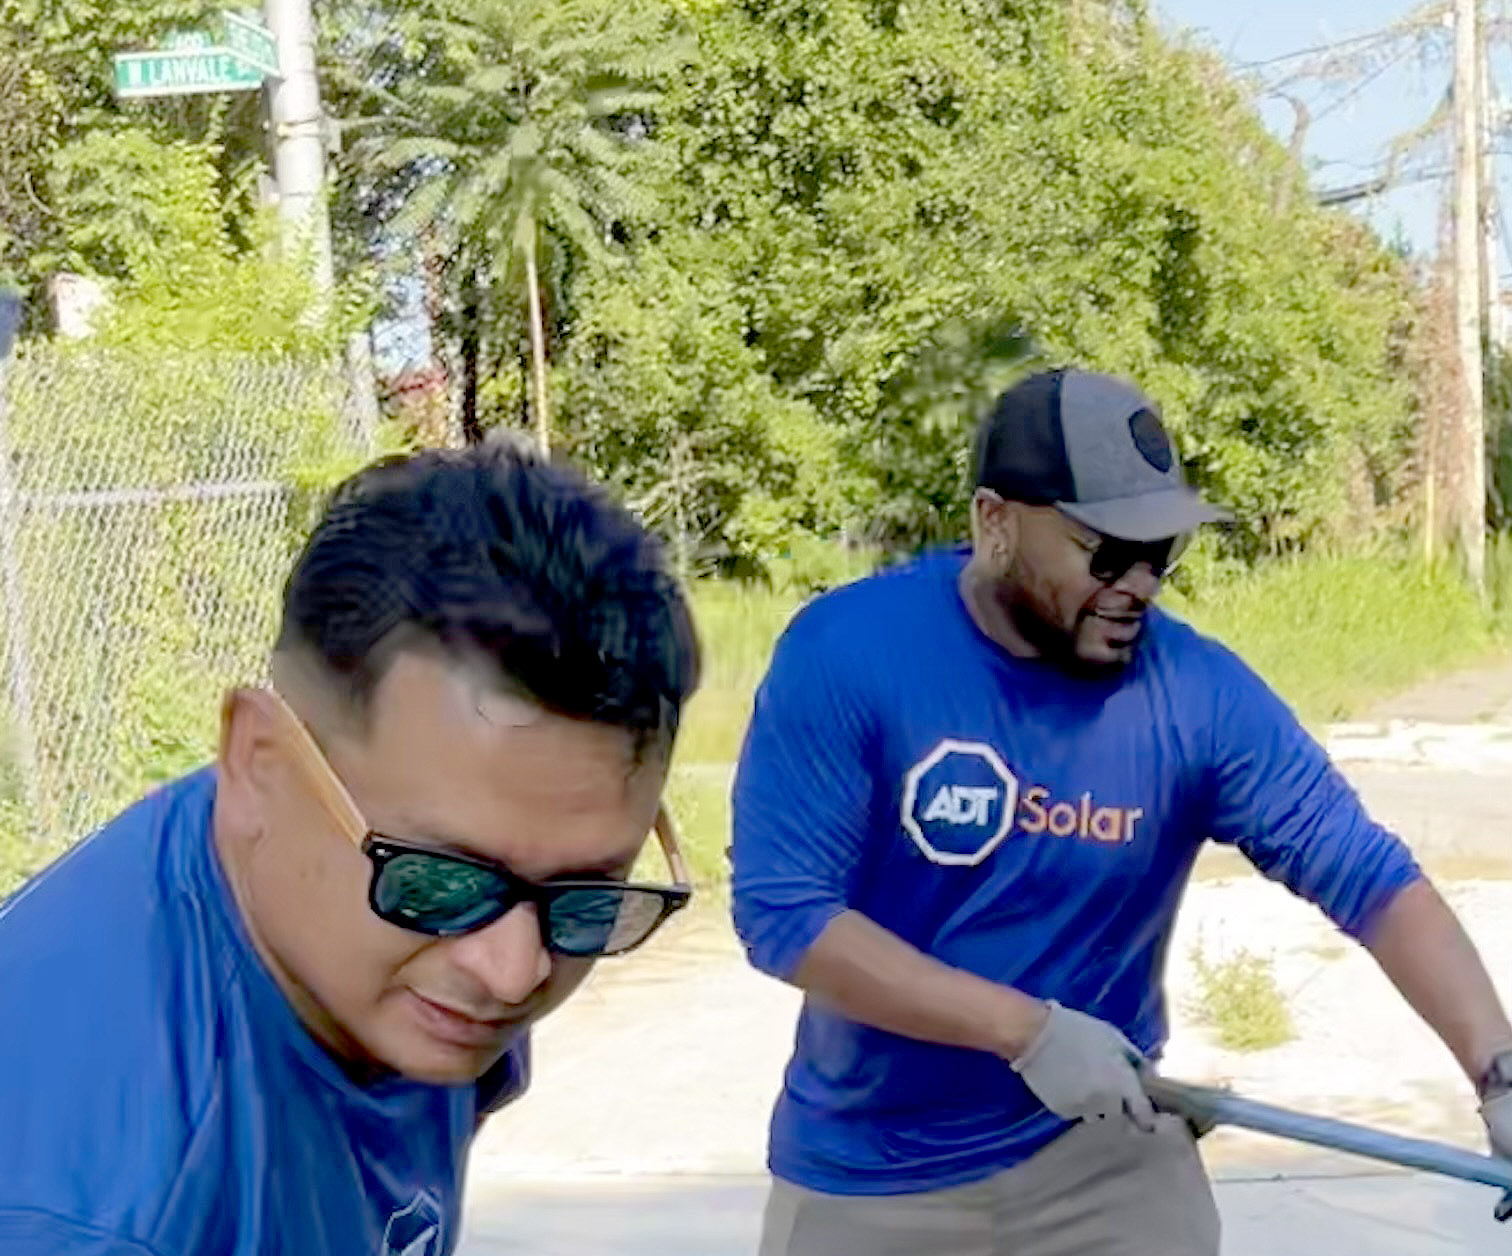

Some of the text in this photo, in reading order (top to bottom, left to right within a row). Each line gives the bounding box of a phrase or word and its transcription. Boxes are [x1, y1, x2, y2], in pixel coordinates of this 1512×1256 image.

[149, 55, 230, 87] LANVALE
[922, 783, 1144, 846] ADT Solar
